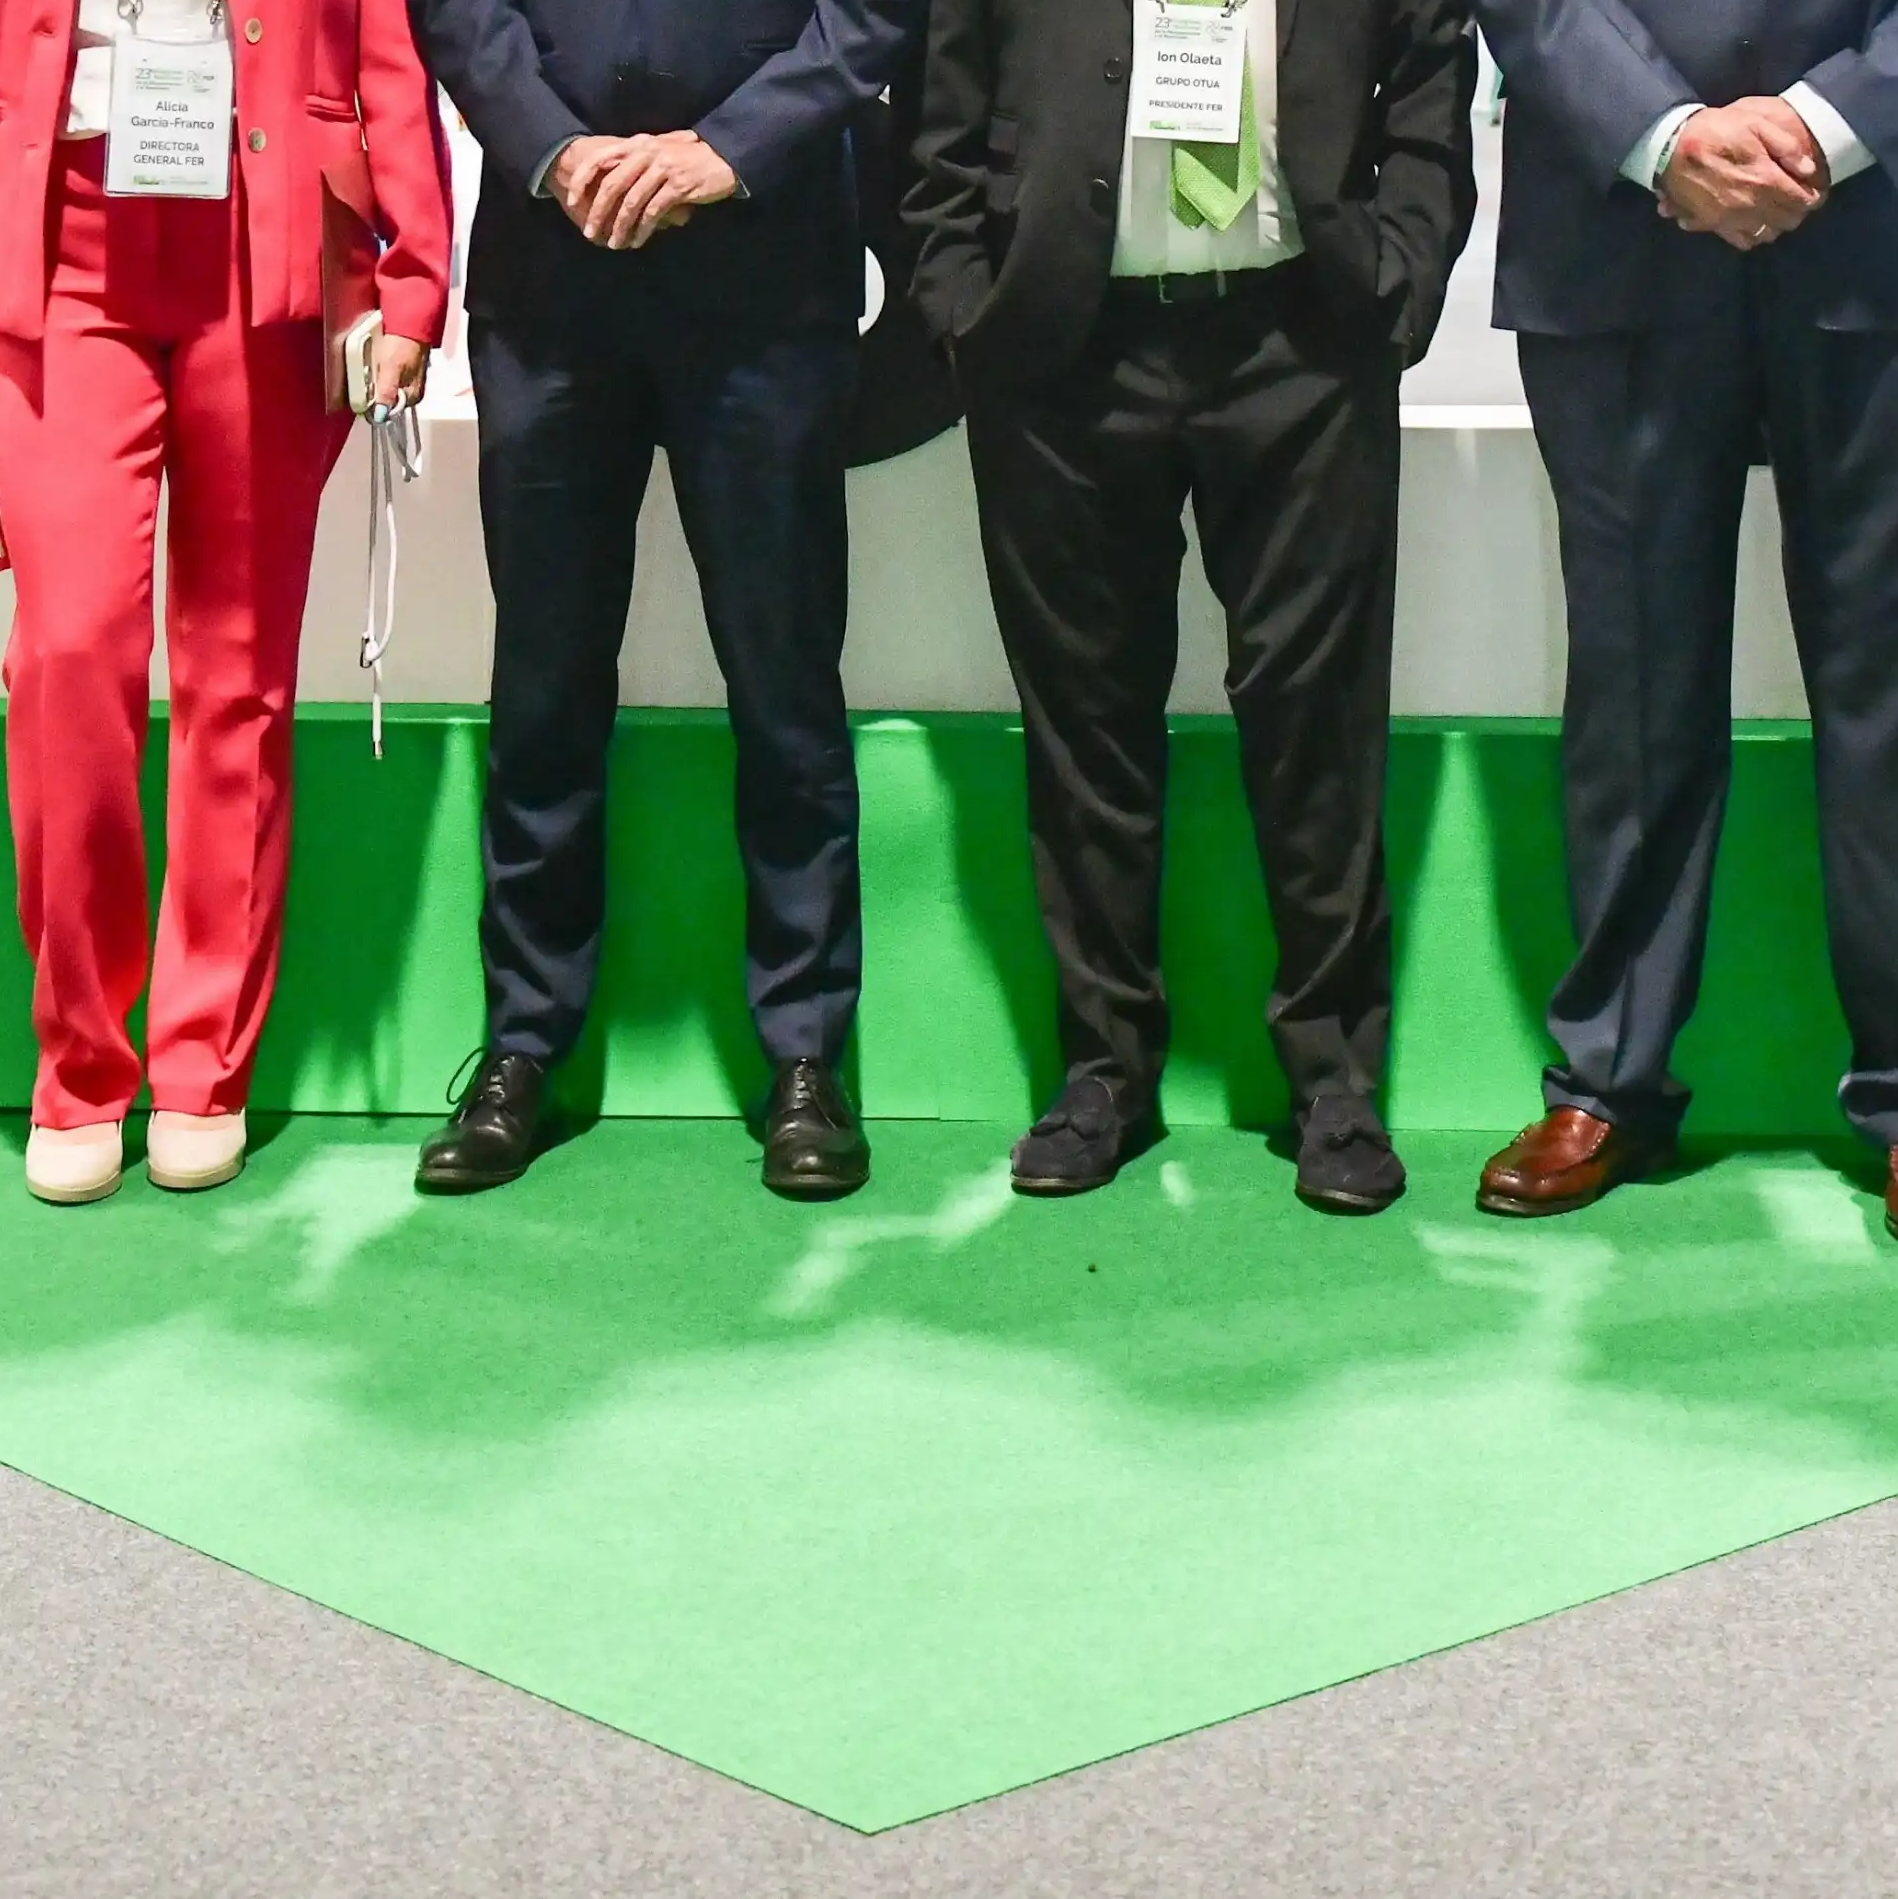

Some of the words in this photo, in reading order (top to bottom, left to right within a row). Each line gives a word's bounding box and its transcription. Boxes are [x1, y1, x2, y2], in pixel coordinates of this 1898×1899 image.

[1157, 51, 1177, 63] Ion
[1180, 52, 1223, 66] Olaeta
[1155, 76, 1191, 87] GRUPO
[1193, 78, 1221, 89] OTUA
[156, 100, 189, 112] Alicia
[1148, 99, 1204, 111] PRESIDENTE
[1206, 102, 1223, 112] FER
[139, 140, 200, 152] DIRECTORA
[132, 154, 182, 166] GENERAL
[184, 156, 205, 166] FER
